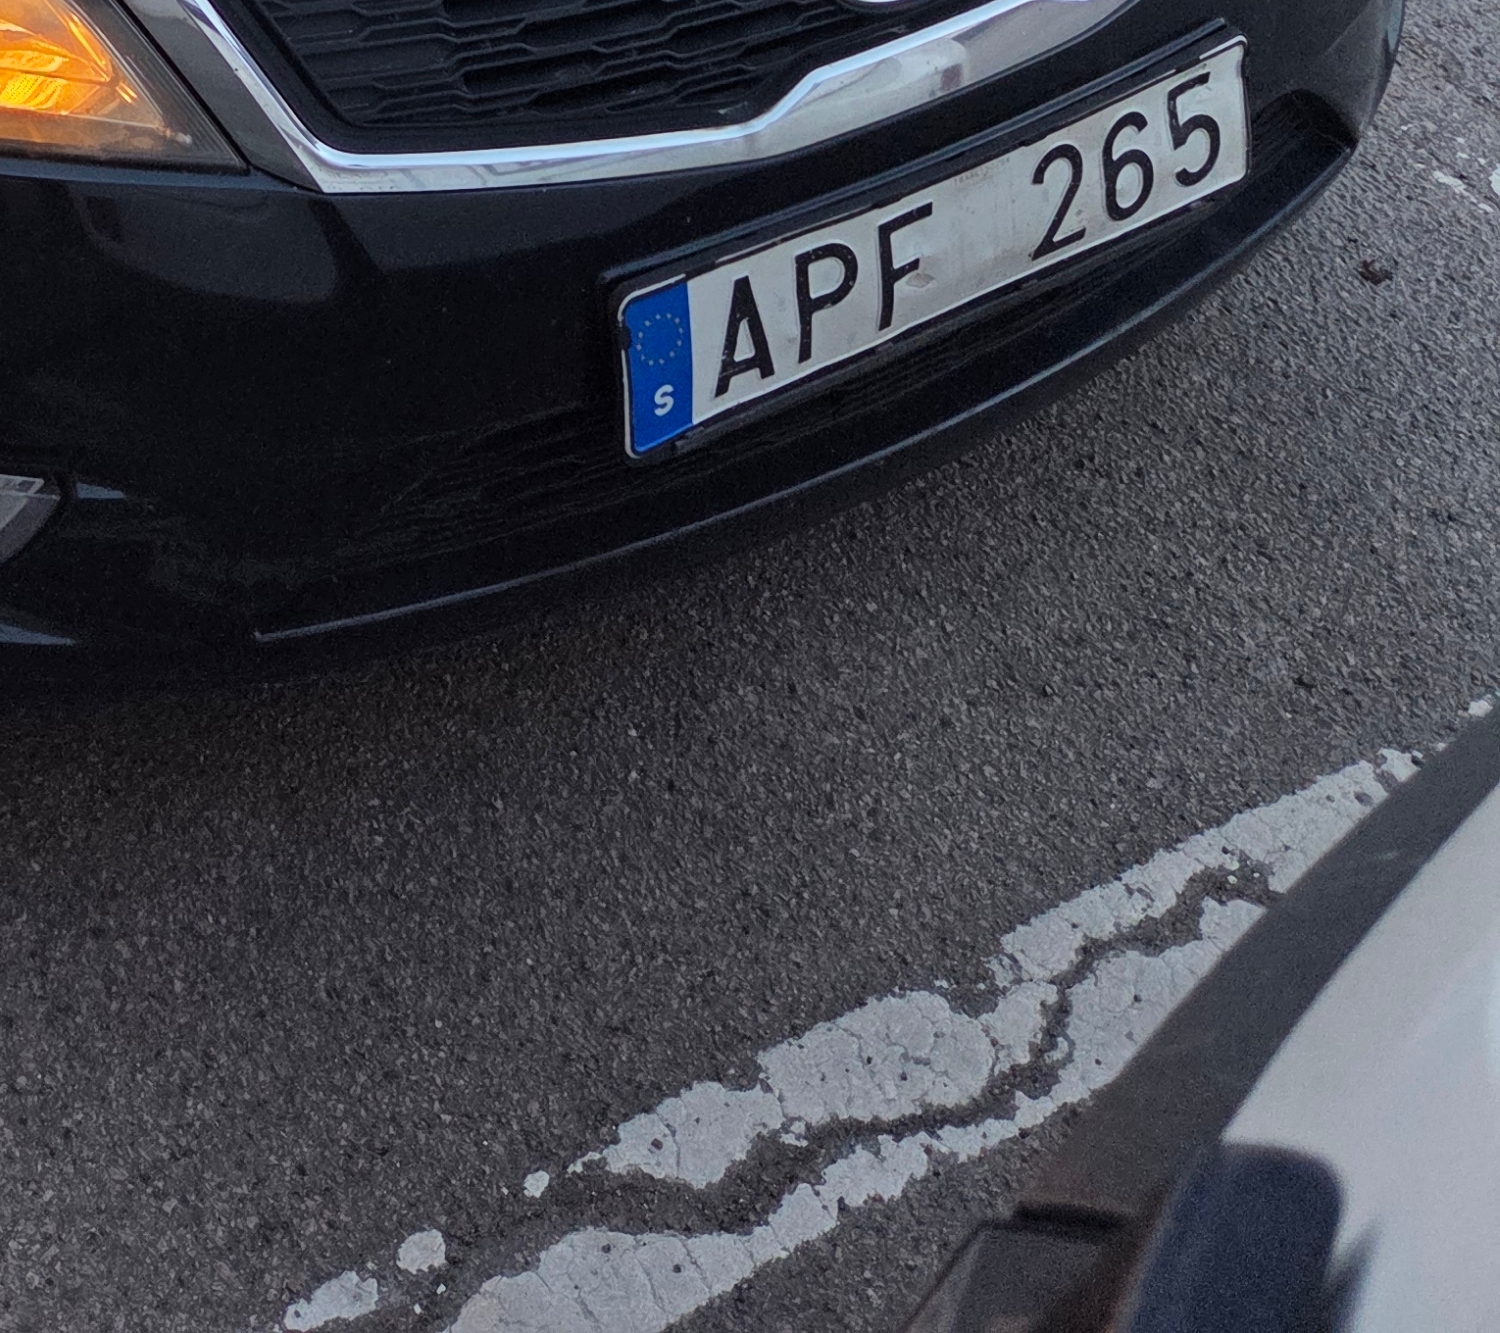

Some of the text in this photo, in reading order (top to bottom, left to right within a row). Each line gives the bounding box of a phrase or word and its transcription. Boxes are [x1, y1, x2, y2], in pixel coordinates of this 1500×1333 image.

[715, 71, 1221, 398] APF 265
[654, 384, 674, 416] S
